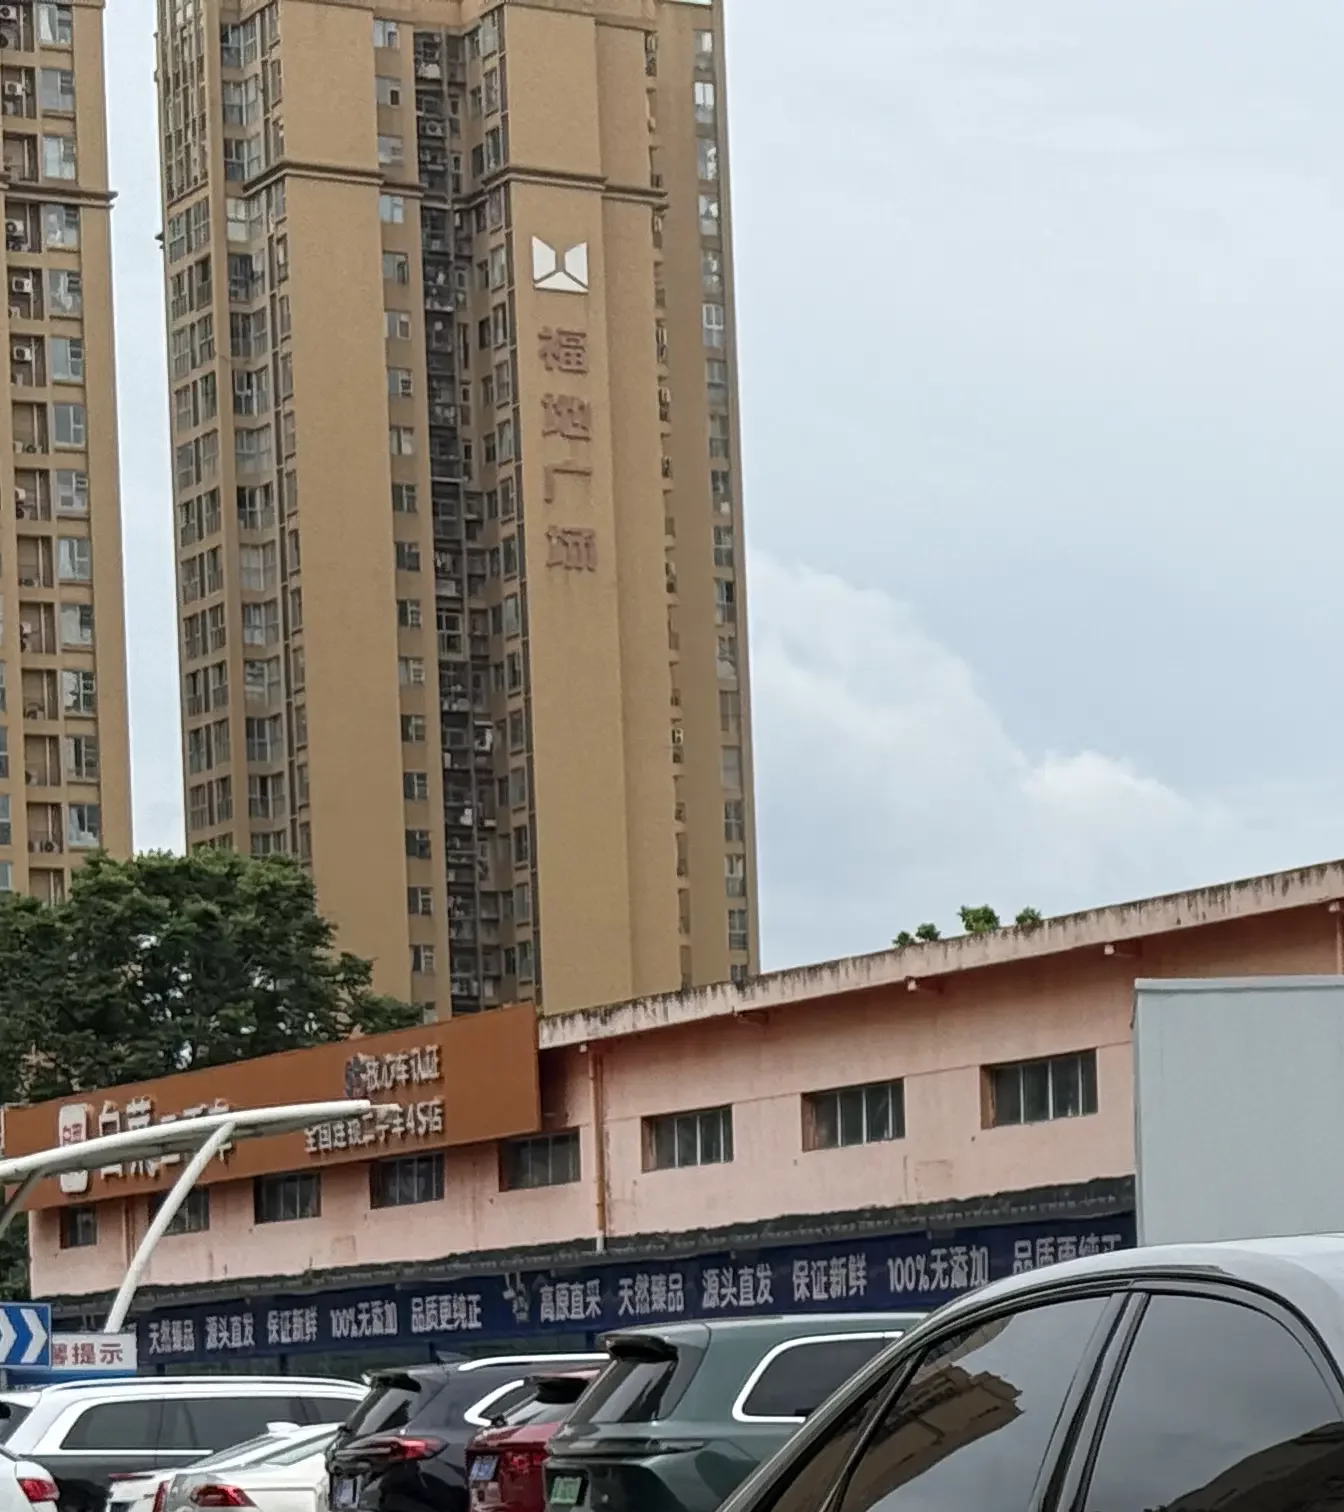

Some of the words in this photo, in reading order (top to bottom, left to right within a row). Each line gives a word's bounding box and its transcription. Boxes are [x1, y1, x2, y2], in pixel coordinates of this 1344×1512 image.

[702, 1262, 774, 1309] 源头直发
[791, 1252, 867, 1302] 保证新鲜
[887, 1246, 990, 1293] 100%无添加
[267, 1306, 318, 1345] 保证新鲜
